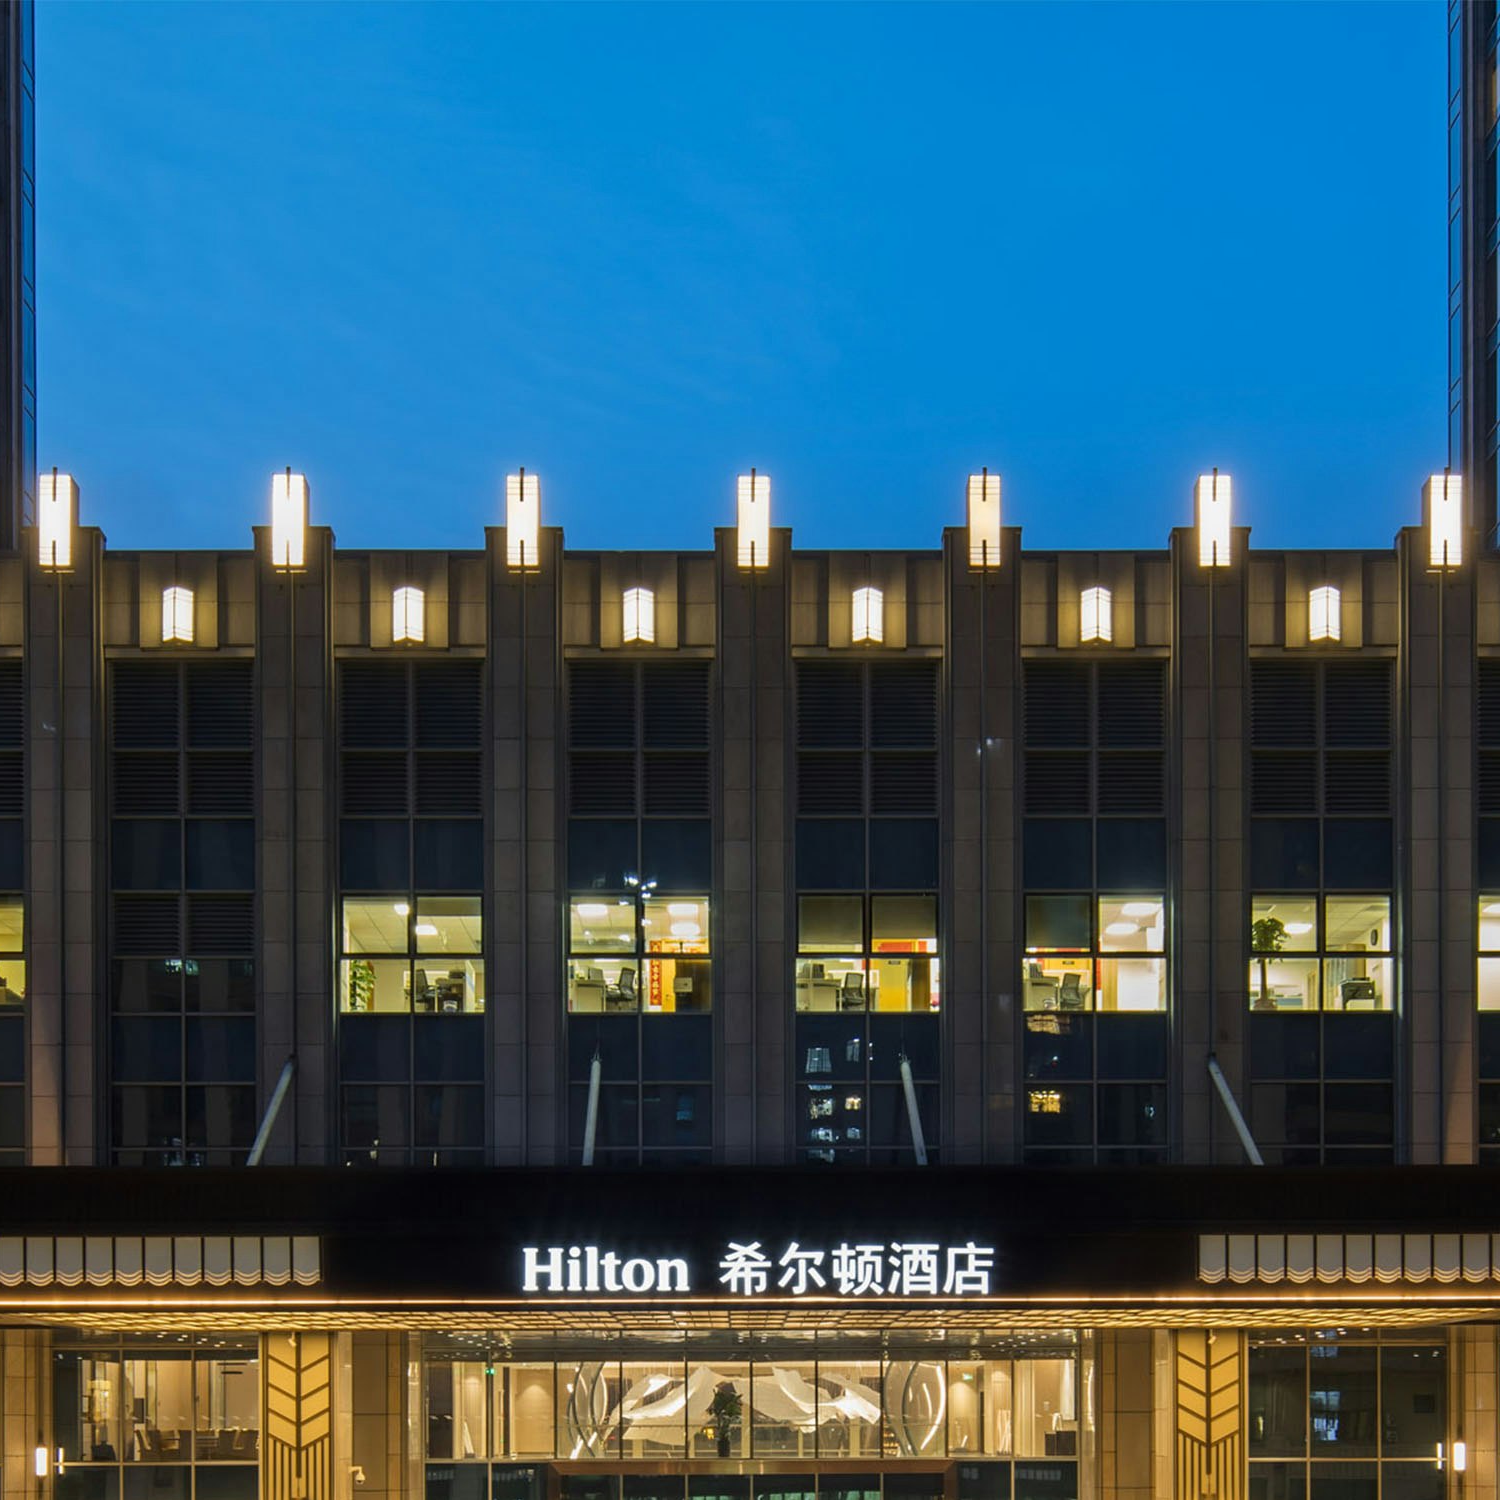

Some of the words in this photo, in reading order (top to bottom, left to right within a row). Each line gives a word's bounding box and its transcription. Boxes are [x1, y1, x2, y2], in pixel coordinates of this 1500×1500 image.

[522, 1246, 691, 1293] Hilton
[718, 1241, 995, 1297] 希尔顿酒店
